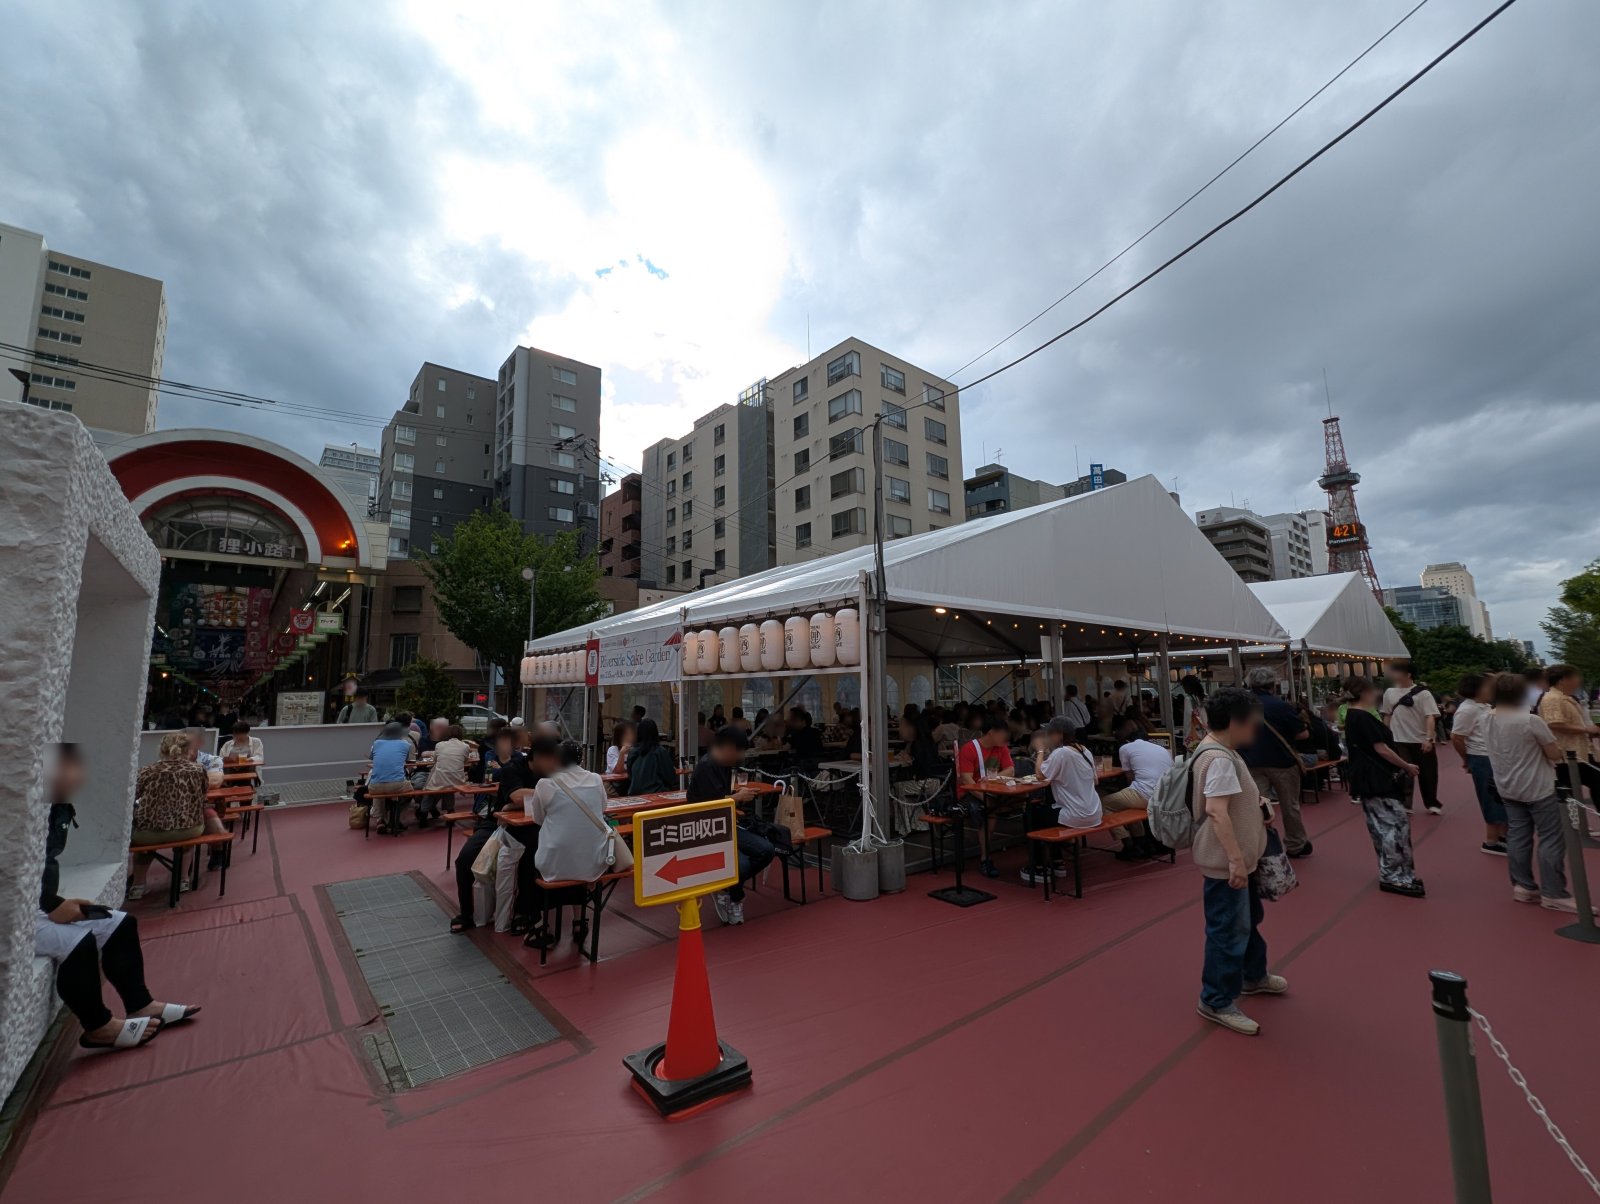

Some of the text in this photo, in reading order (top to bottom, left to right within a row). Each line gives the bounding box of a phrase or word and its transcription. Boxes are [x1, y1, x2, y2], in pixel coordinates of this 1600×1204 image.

[1329, 536, 1359, 544] Panasonic
[600, 653, 626, 669] Riverside
[626, 650, 645, 667] Sake
[647, 648, 671, 664] Garden
[650, 816, 727, 847] ゴミ回収口
